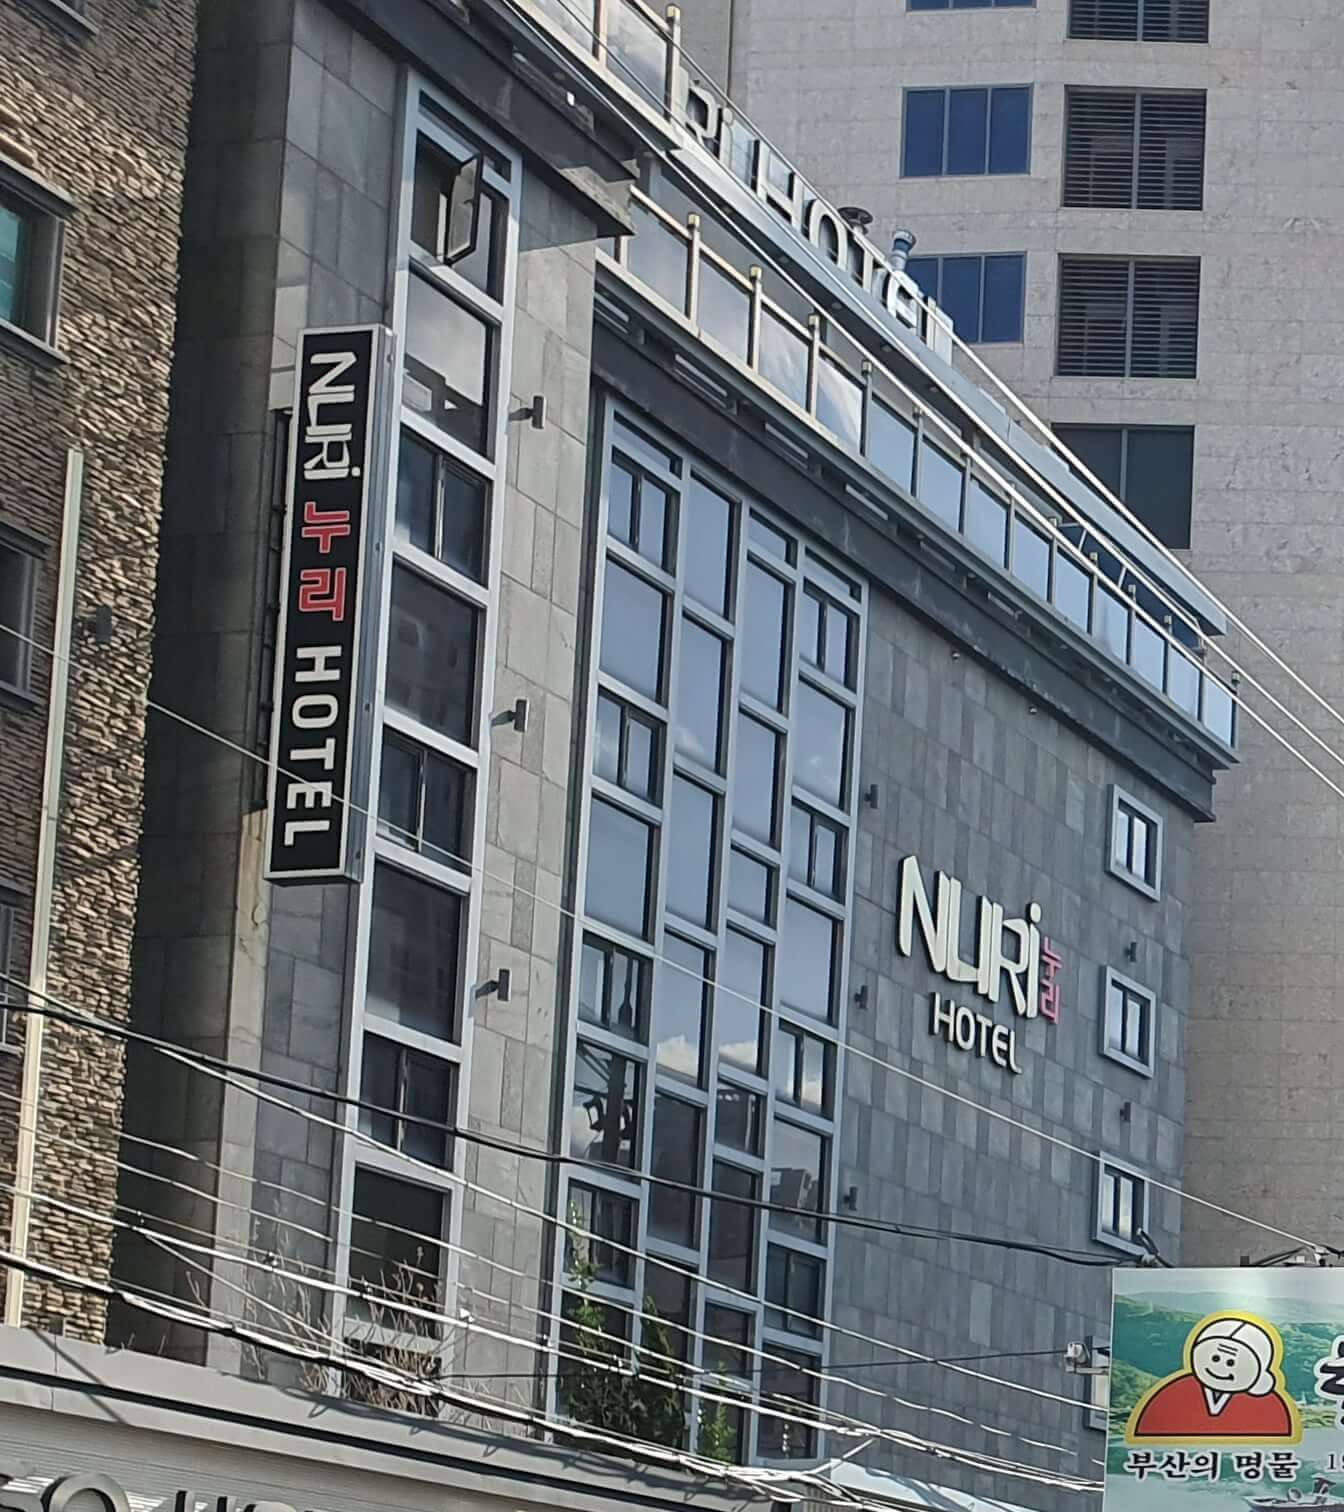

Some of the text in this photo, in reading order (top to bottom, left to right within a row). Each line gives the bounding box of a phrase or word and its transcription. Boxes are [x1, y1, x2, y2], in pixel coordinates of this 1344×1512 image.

[284, 645, 342, 847] HOTEL
[928, 991, 1023, 1075] HOTEL
[1127, 1451, 1298, 1480] 부산의 명물
